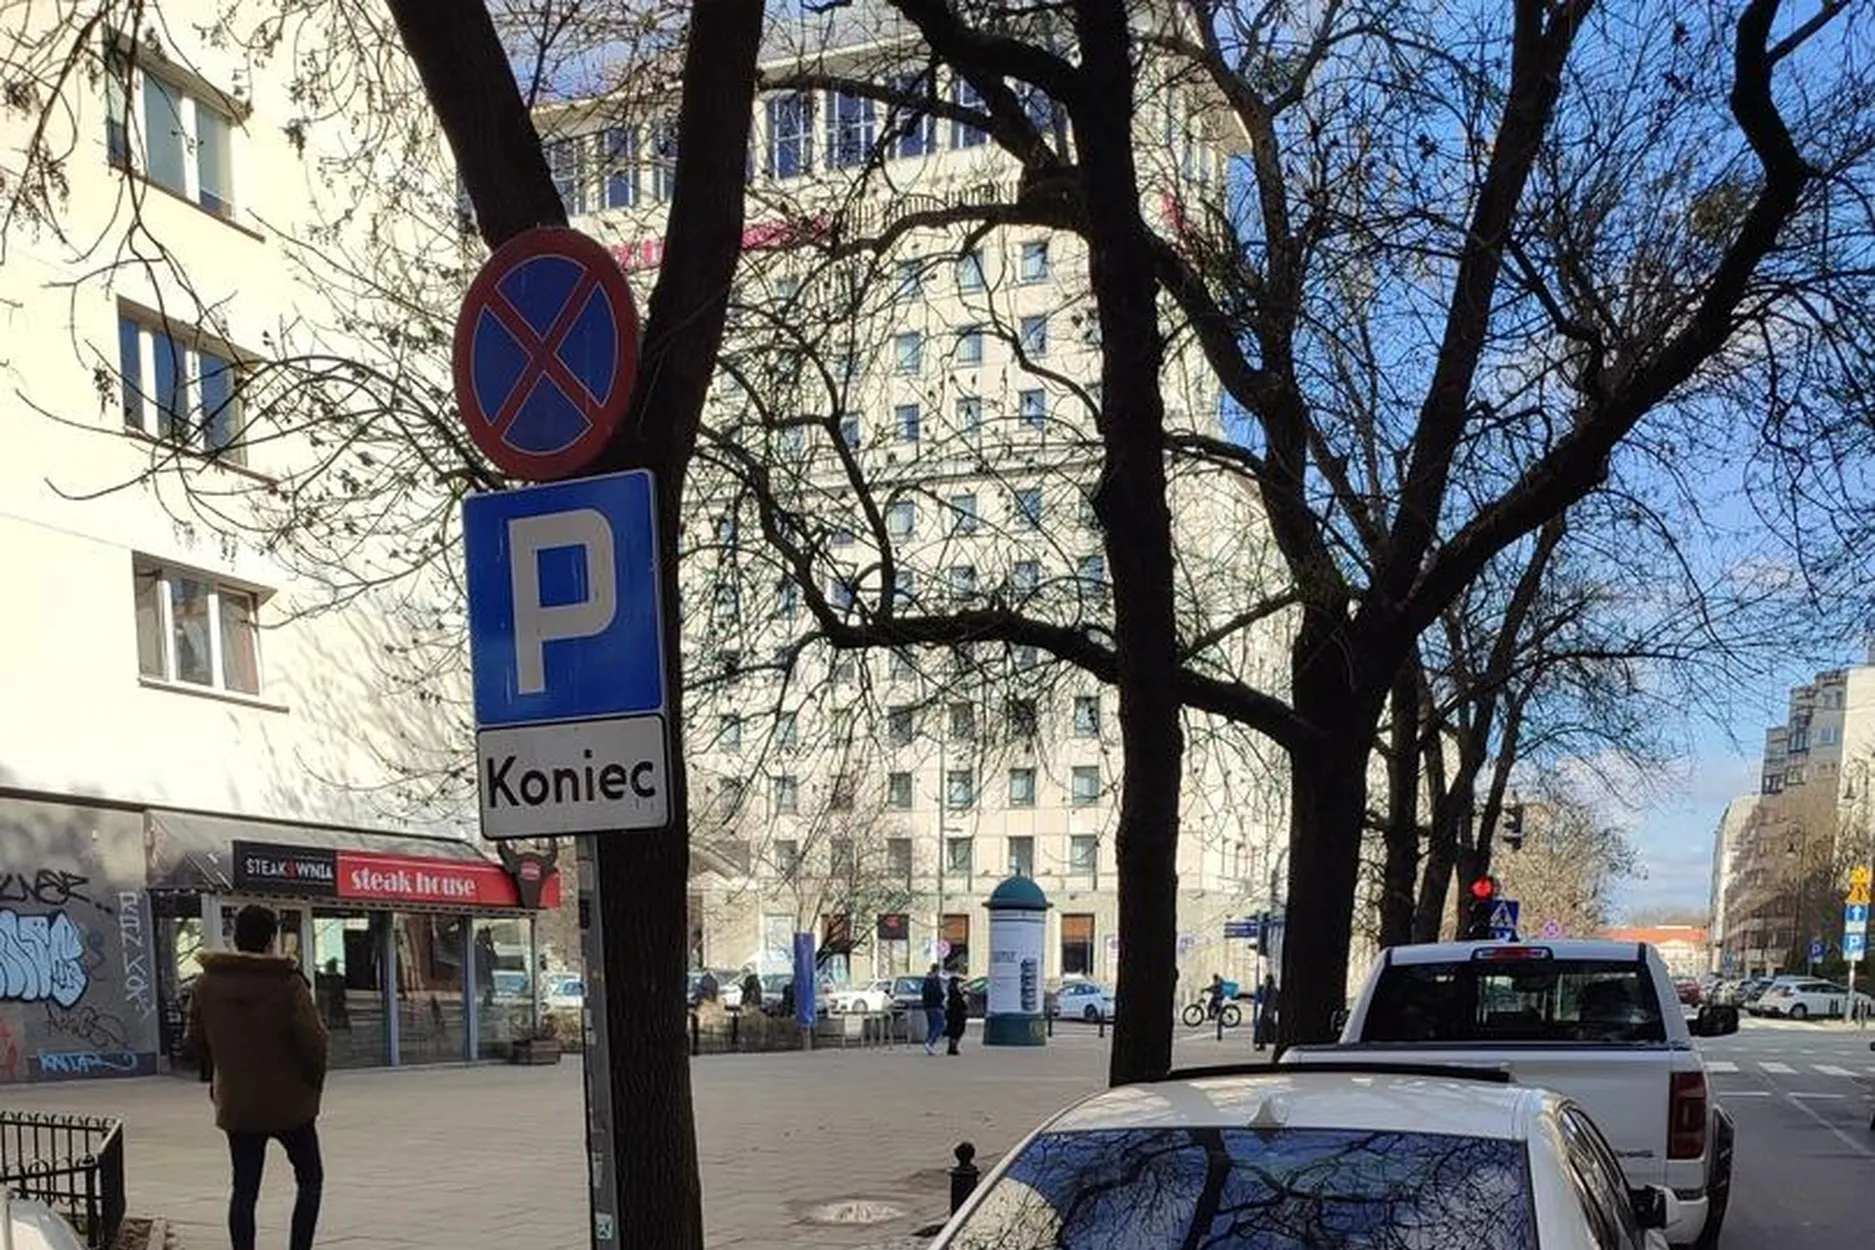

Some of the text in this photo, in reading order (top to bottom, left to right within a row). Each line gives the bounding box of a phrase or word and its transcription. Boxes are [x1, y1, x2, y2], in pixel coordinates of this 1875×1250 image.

[508, 508, 617, 694] P
[486, 748, 656, 808] Koniec
[351, 866, 477, 896] steak house
